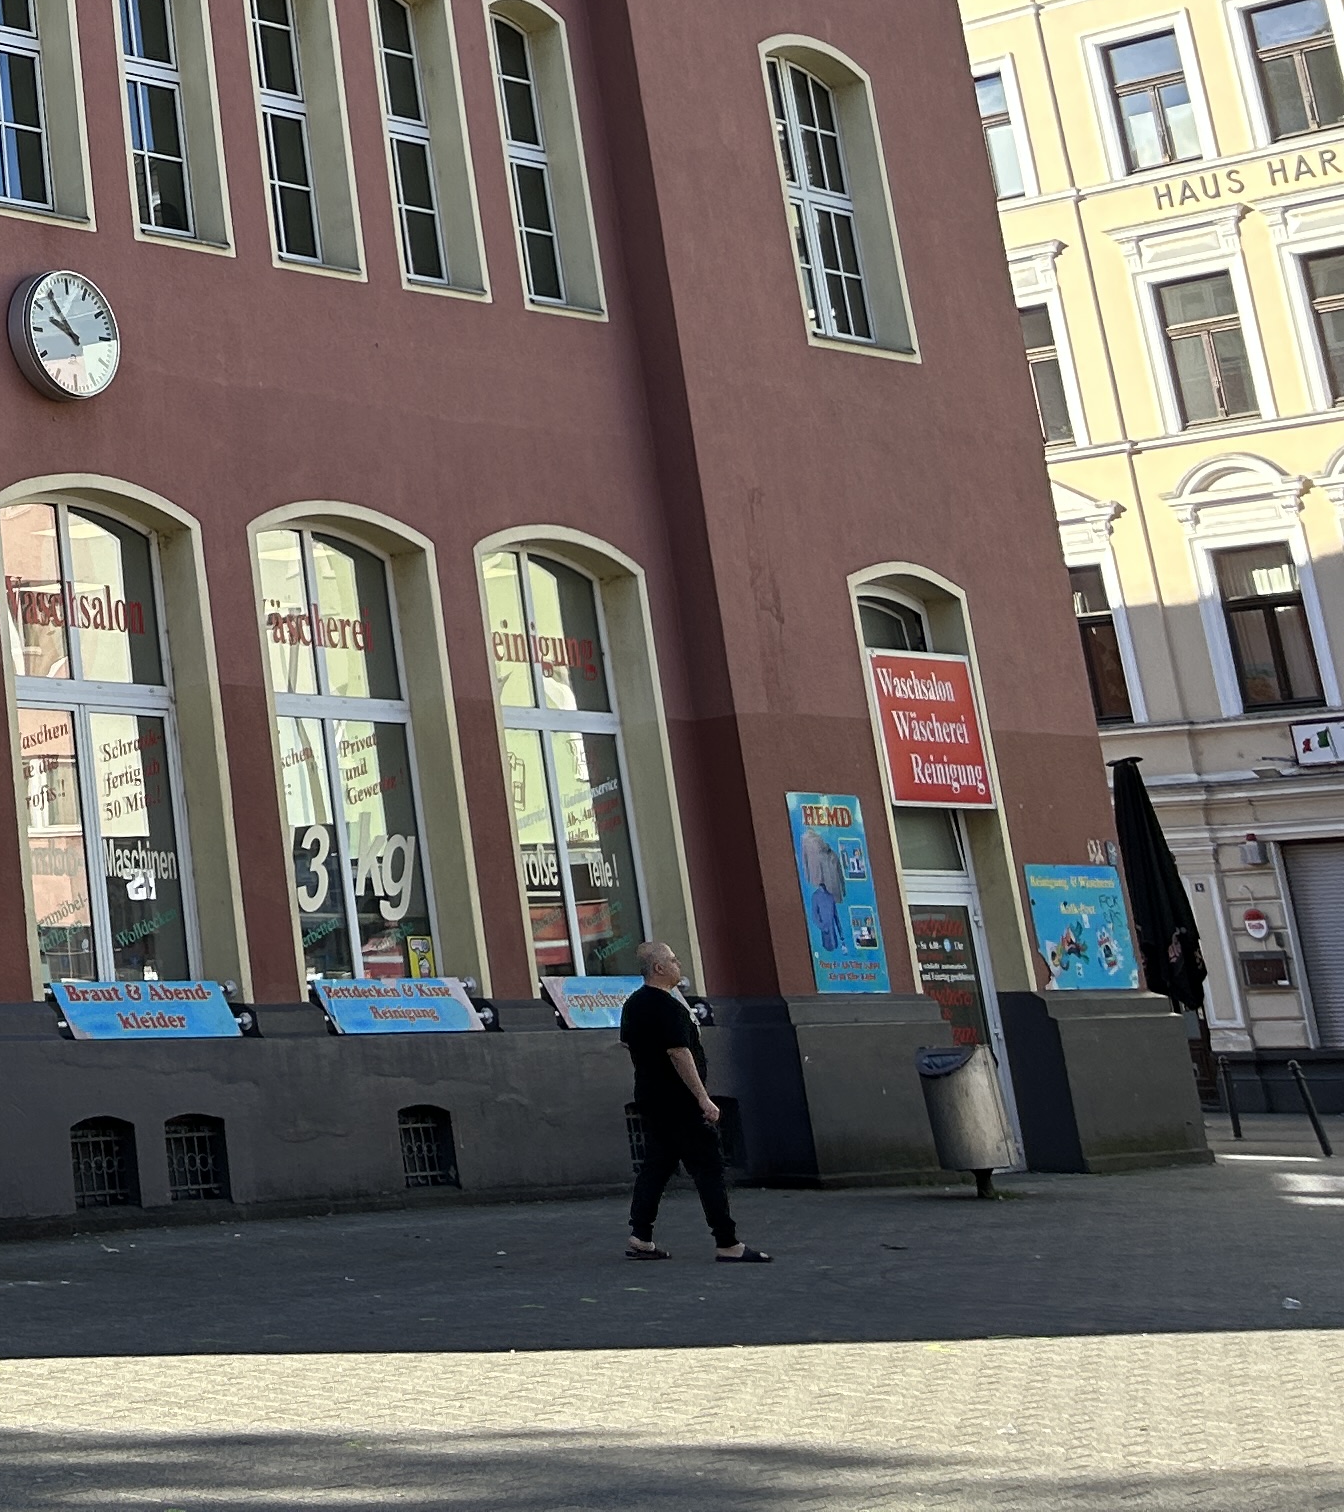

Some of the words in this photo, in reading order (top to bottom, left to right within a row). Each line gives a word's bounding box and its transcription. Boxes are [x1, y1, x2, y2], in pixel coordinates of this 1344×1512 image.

[1153, 169, 1245, 211] HAUS
[1267, 149, 1343, 187] HAR
[263, 598, 374, 654] äscherei
[876, 667, 956, 703] Waschsalon
[20, 722, 69, 750] aschen
[891, 710, 970, 745] Wäscherei
[105, 764, 142, 796] fertig
[345, 757, 368, 781] und
[909, 753, 986, 796] Reinigung
[105, 800, 123, 821] 50
[802, 805, 852, 828] HEMD
[103, 839, 178, 880] Maschinen
[355, 812, 416, 921] kg
[584, 852, 613, 887] Teile
[65, 984, 123, 1002] Braut
[124, 984, 142, 1001] &
[148, 984, 211, 1001] Abend-
[117, 1012, 187, 1029] kleider
[370, 1005, 439, 1021] Reinigung
